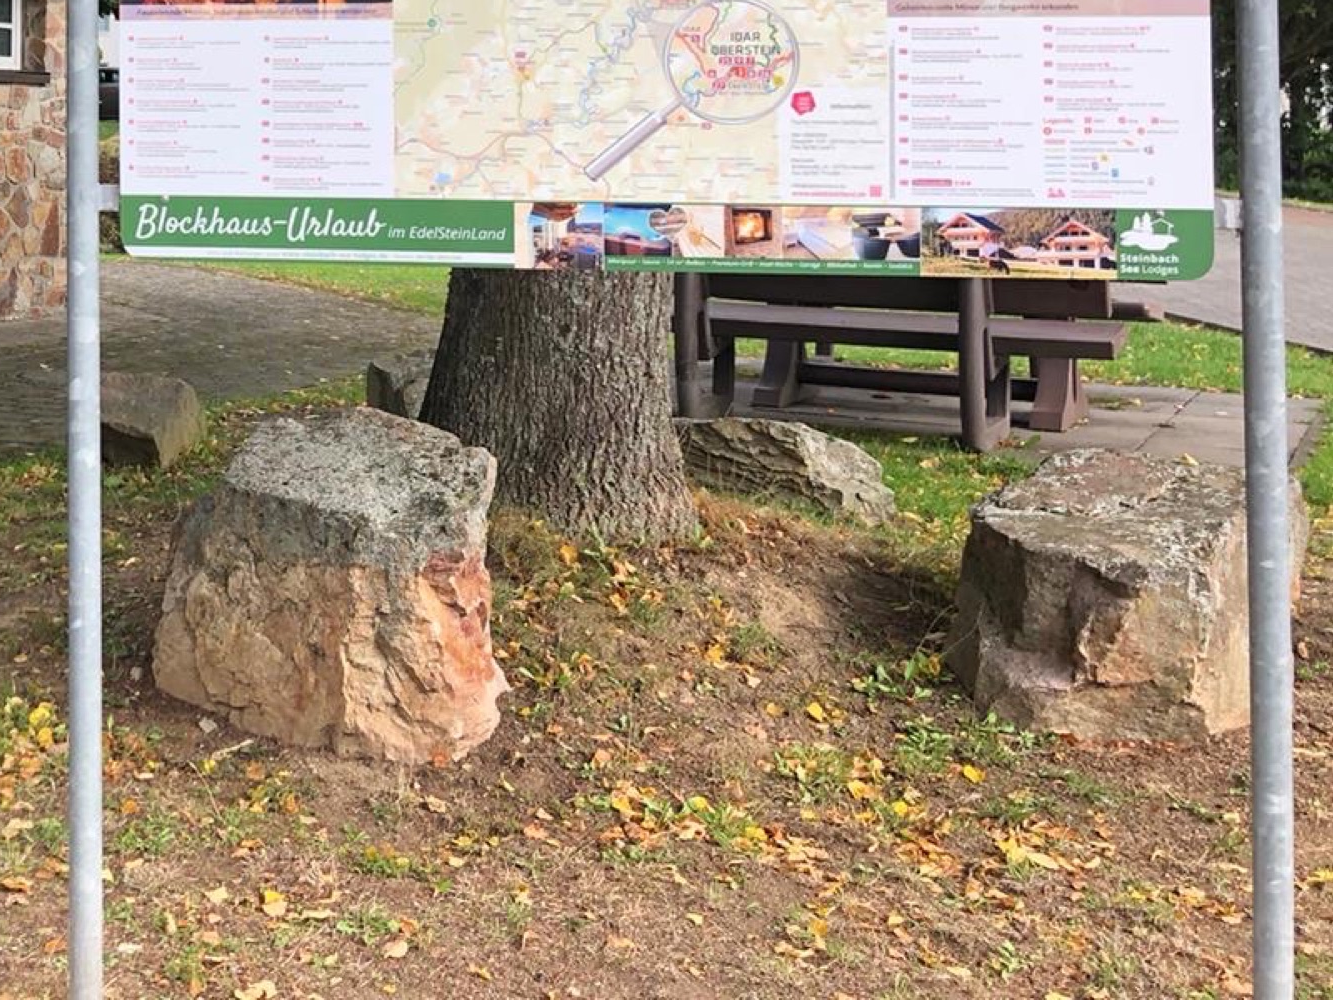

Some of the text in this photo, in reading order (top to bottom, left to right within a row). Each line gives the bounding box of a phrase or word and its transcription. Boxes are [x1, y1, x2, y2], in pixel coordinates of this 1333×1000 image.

[730, 31, 761, 42] IDAR
[135, 203, 507, 242] Blockhaus-Urlaub im EdelSteinLand
[1120, 253, 1179, 263] Steinbach
[1120, 264, 1179, 276] See Lodges
